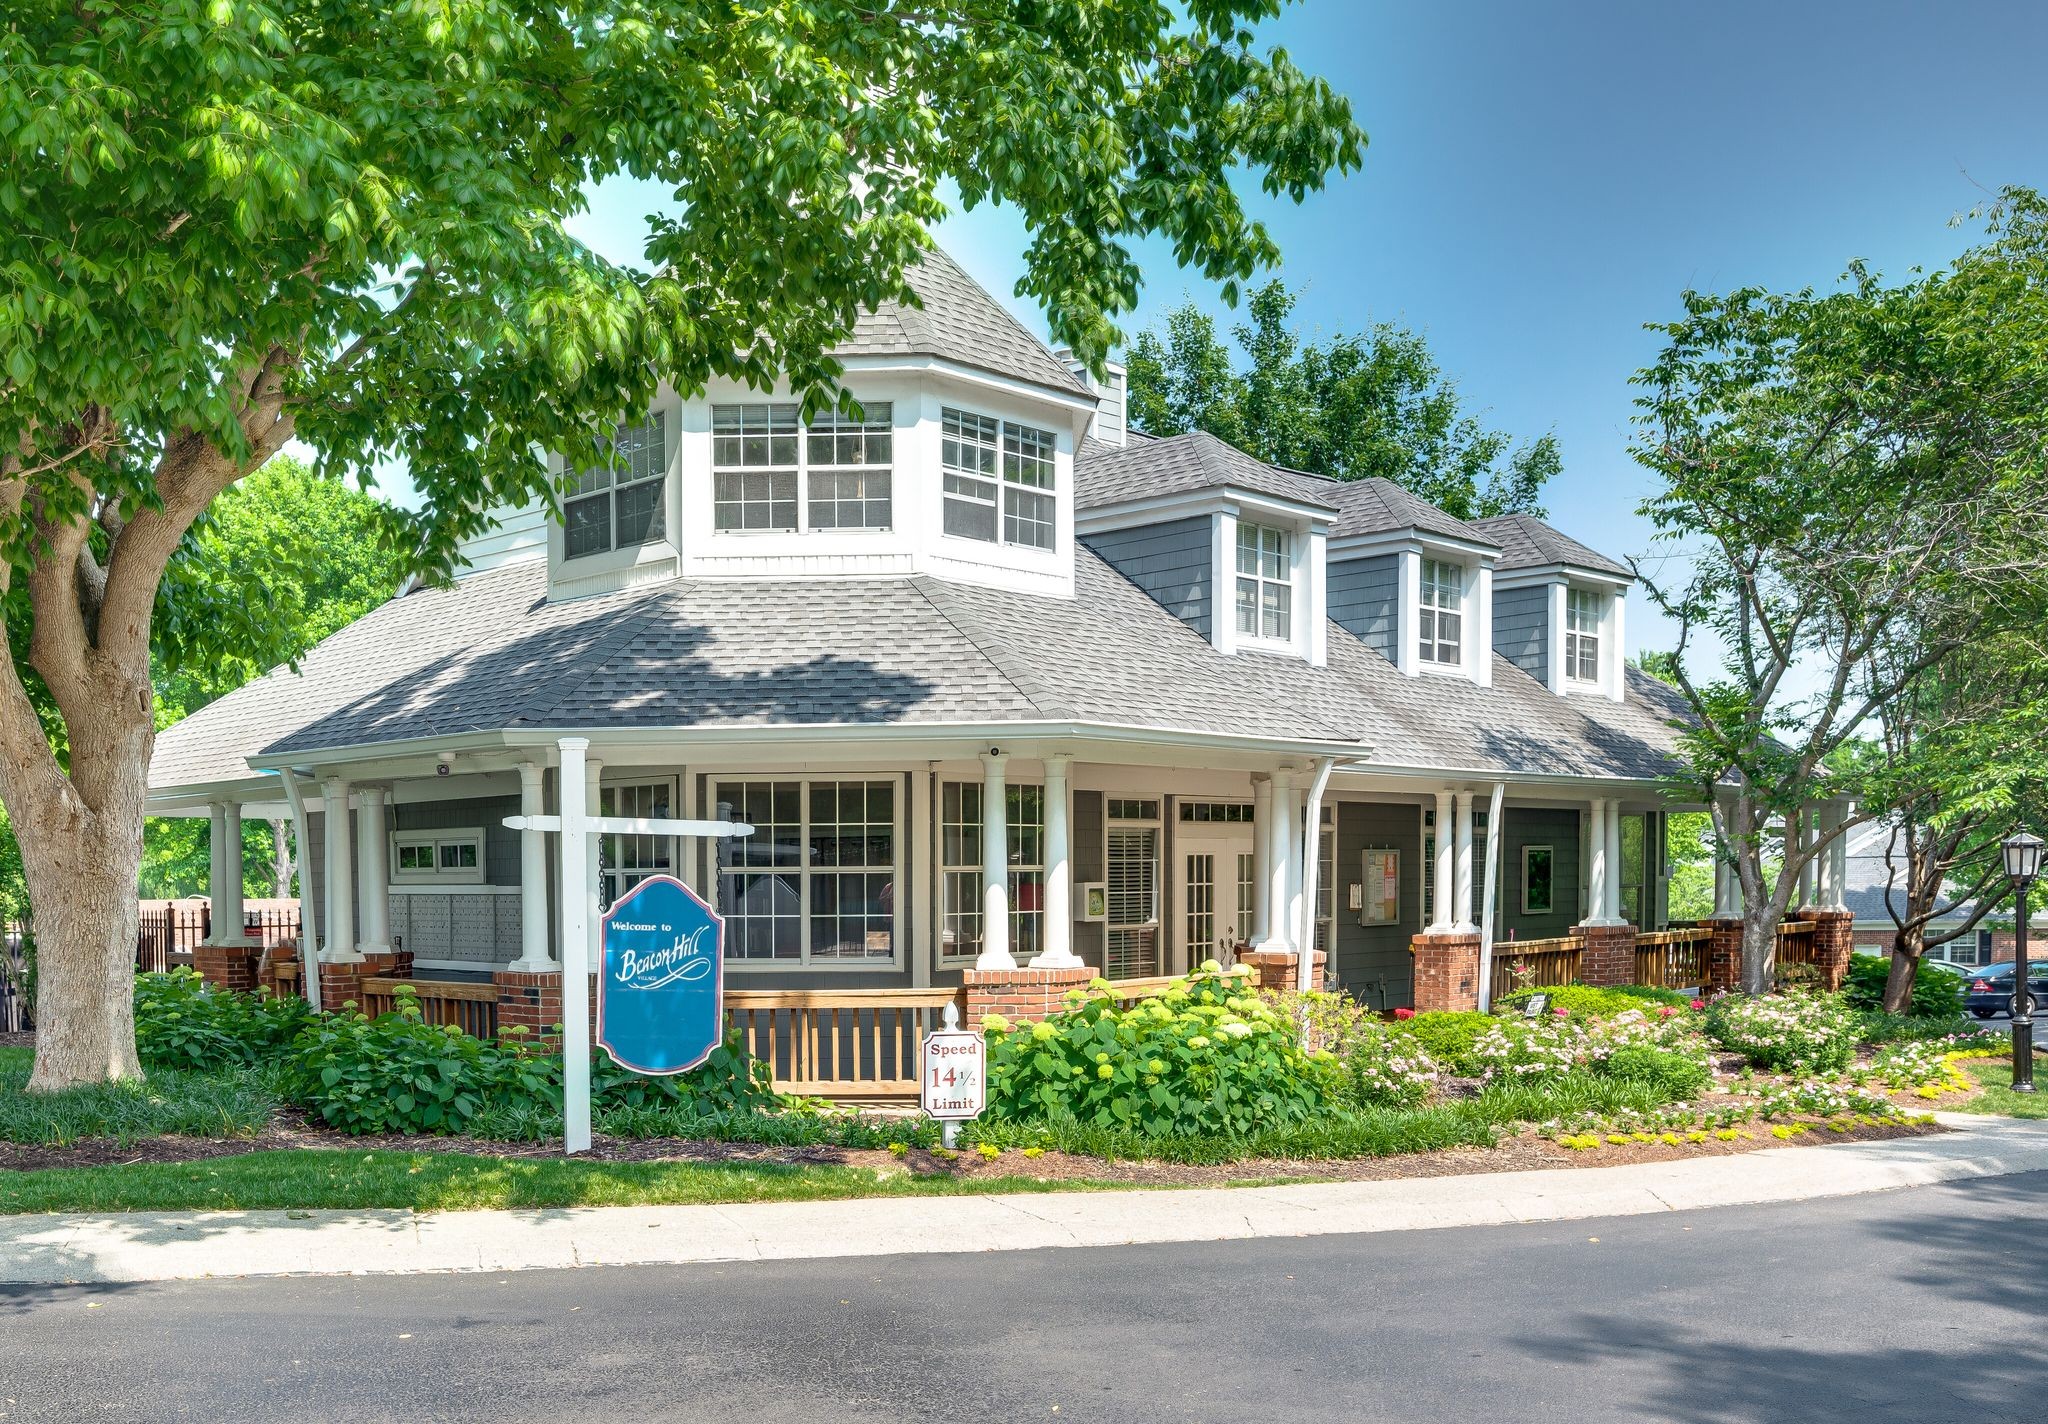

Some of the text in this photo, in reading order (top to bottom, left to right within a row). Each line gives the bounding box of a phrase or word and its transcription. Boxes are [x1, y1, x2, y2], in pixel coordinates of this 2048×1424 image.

[611, 921, 672, 931] Welcome to
[669, 925, 710, 963] Hill
[930, 1043, 977, 1058] Speed
[931, 1066, 957, 1088] 14
[932, 1097, 974, 1110] Limit
